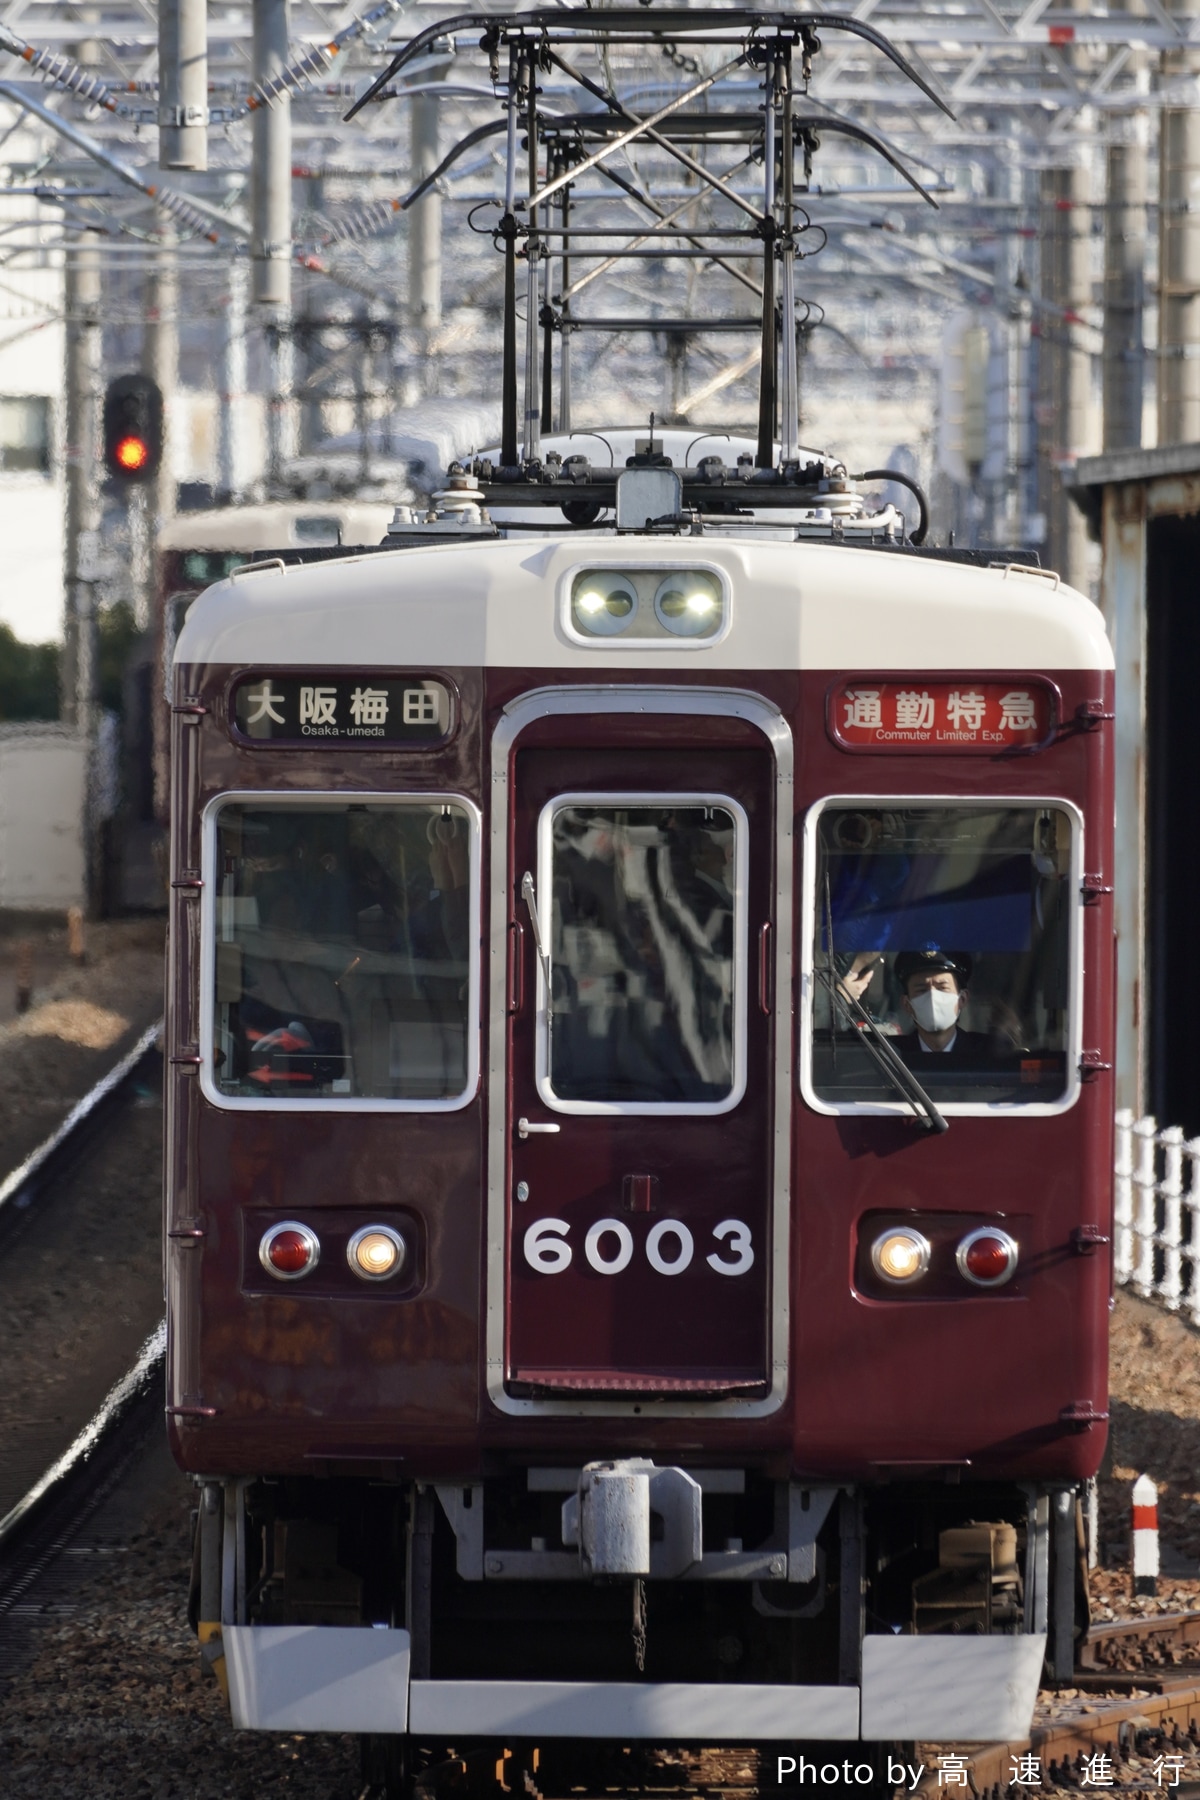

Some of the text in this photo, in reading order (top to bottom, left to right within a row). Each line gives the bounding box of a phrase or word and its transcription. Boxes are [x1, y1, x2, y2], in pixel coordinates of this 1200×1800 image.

[247, 686, 439, 725] 大阪梅田
[843, 690, 1037, 730] 通勤特急
[301, 725, 385, 737] Osaka-umeda
[876, 729, 1005, 742] Commuter Limited Exp.
[523, 1217, 755, 1276] 6003
